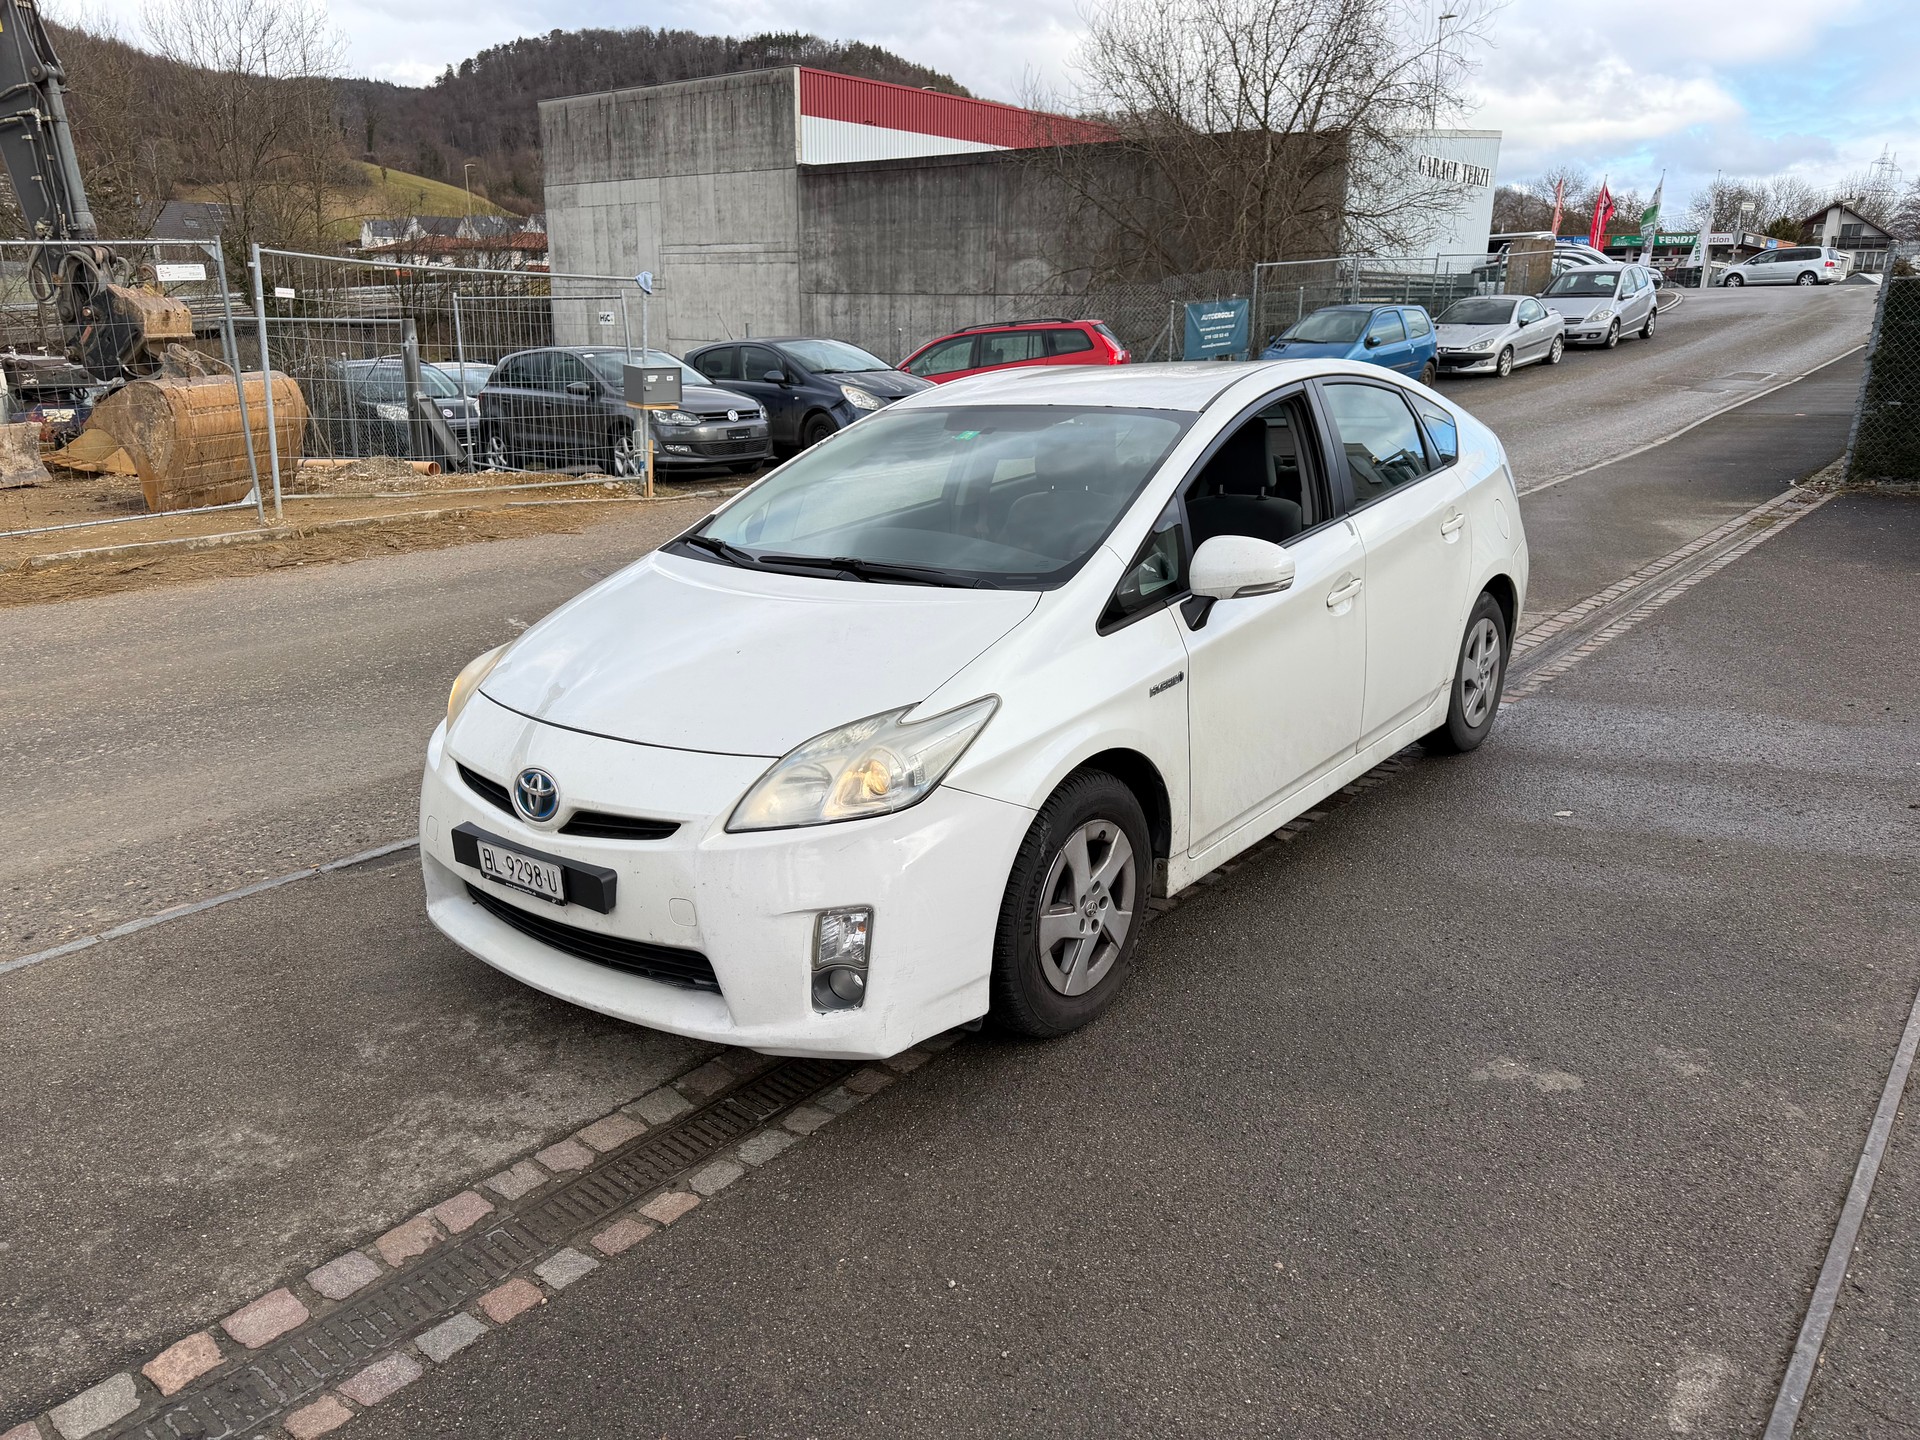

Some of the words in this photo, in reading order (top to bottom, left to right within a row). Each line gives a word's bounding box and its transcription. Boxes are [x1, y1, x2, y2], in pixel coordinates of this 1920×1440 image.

[1418, 154, 1459, 182] GARAGE
[1462, 163, 1490, 187] TERZI
[1658, 235, 1698, 244] FENDT
[482, 847, 504, 875] BL
[504, 853, 544, 889] 9298
[546, 868, 558, 894] U
